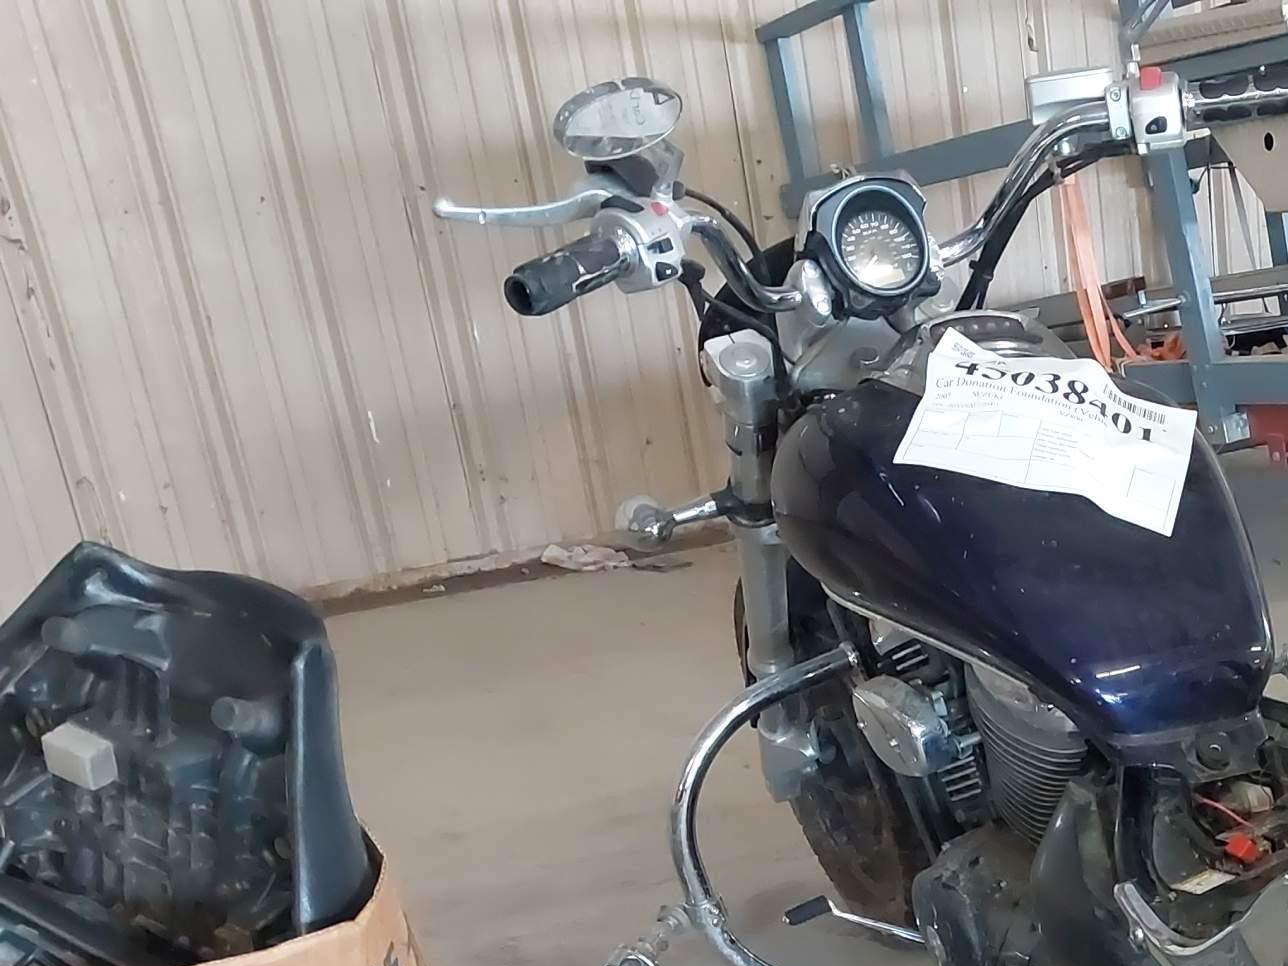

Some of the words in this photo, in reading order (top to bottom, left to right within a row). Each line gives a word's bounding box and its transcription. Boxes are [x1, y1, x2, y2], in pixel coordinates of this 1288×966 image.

[935, 377, 954, 389] Car
[956, 376, 1006, 393] Donation
[1010, 385, 1072, 411] Foundation
[955, 360, 1152, 442] 45038401
